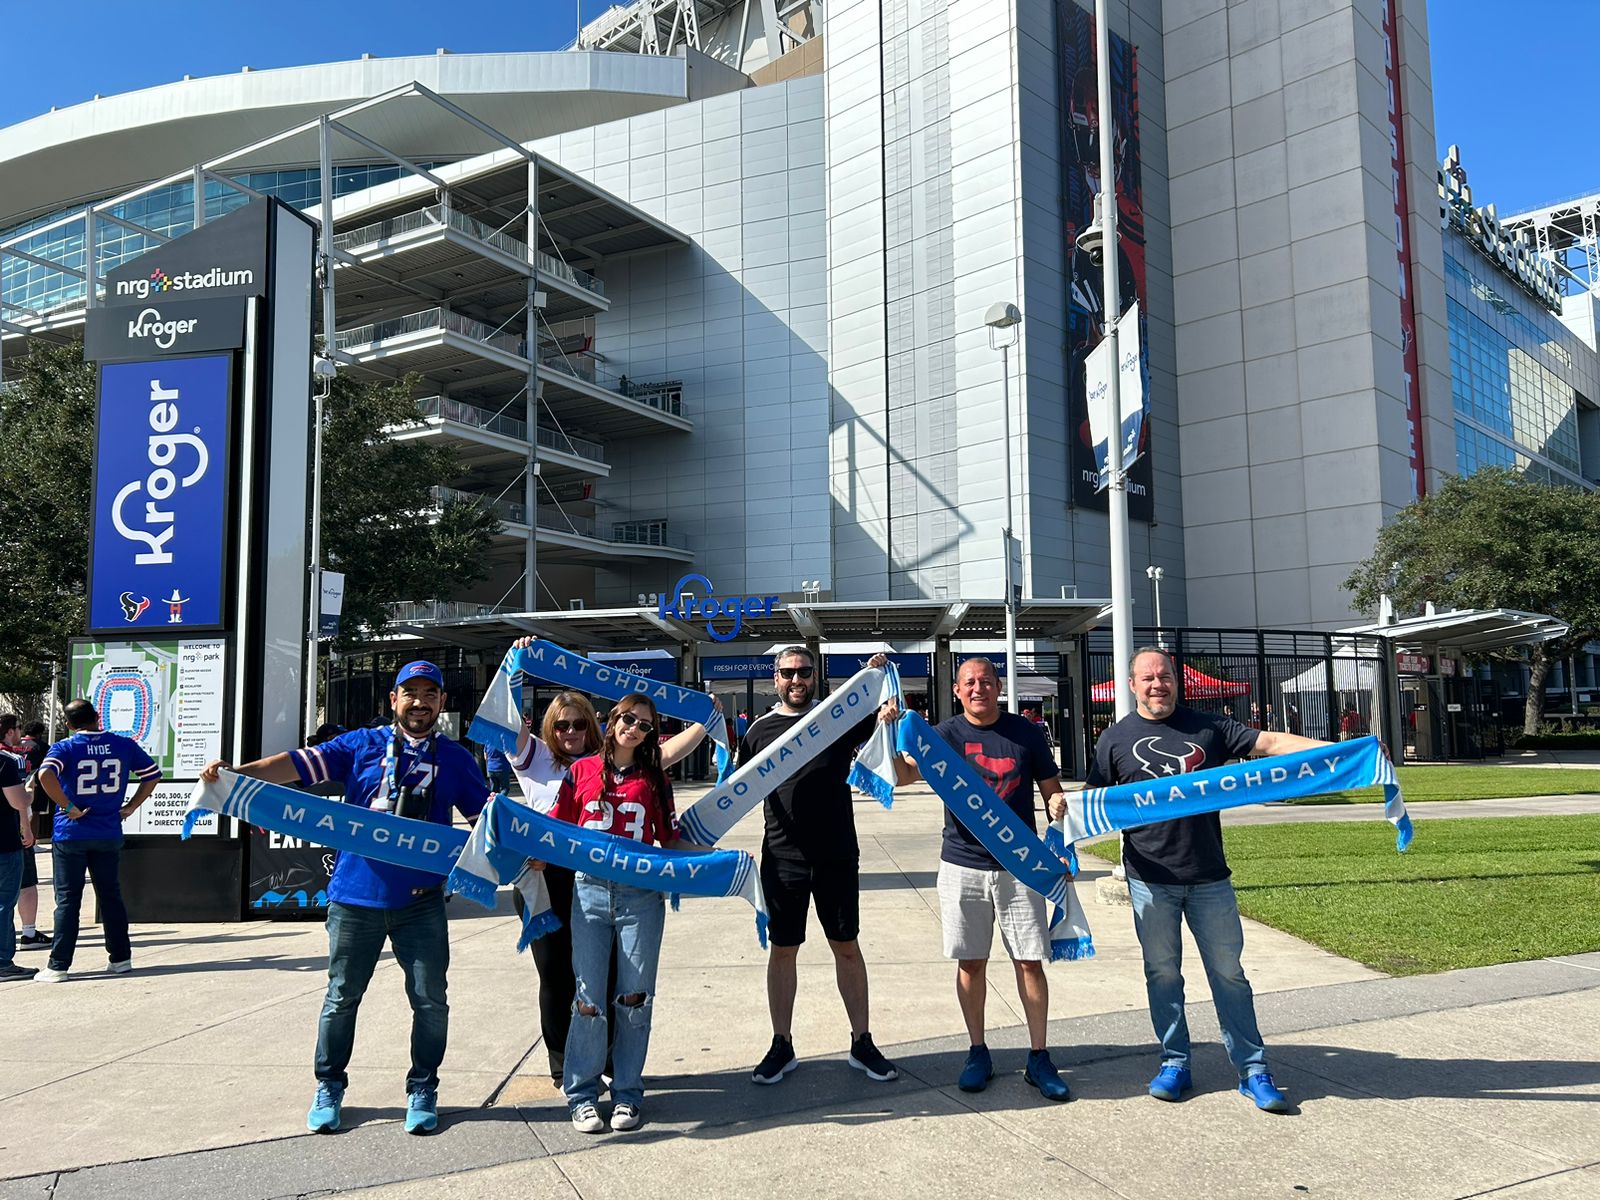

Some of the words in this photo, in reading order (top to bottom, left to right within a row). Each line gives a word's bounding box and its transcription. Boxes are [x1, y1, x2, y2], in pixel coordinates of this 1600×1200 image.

[116, 279, 150, 299] nrg
[173, 267, 253, 291] stadium
[1480, 203, 1562, 316] stadium
[128, 307, 198, 349] Kroger
[111, 379, 209, 565] Kroger
[1082, 469, 1098, 489] nrg
[658, 573, 779, 642] Kroger
[183, 654, 196, 663] nrg
[204, 653, 220, 662] park
[527, 646, 690, 704] MATCHDAY
[749, 663, 775, 671] EVERYO
[87, 743, 112, 755] HYDE
[716, 781, 748, 811] GO
[756, 721, 821, 778] MATE
[830, 683, 870, 720] GO!
[76, 758, 122, 796] 23
[370, 757, 439, 809] 17
[1133, 755, 1341, 808] MATCHDAY
[583, 800, 646, 843] 23
[917, 735, 1049, 873] MATCHDAY
[282, 803, 464, 859] MATCHDA
[510, 816, 702, 879] MATCHDAY
